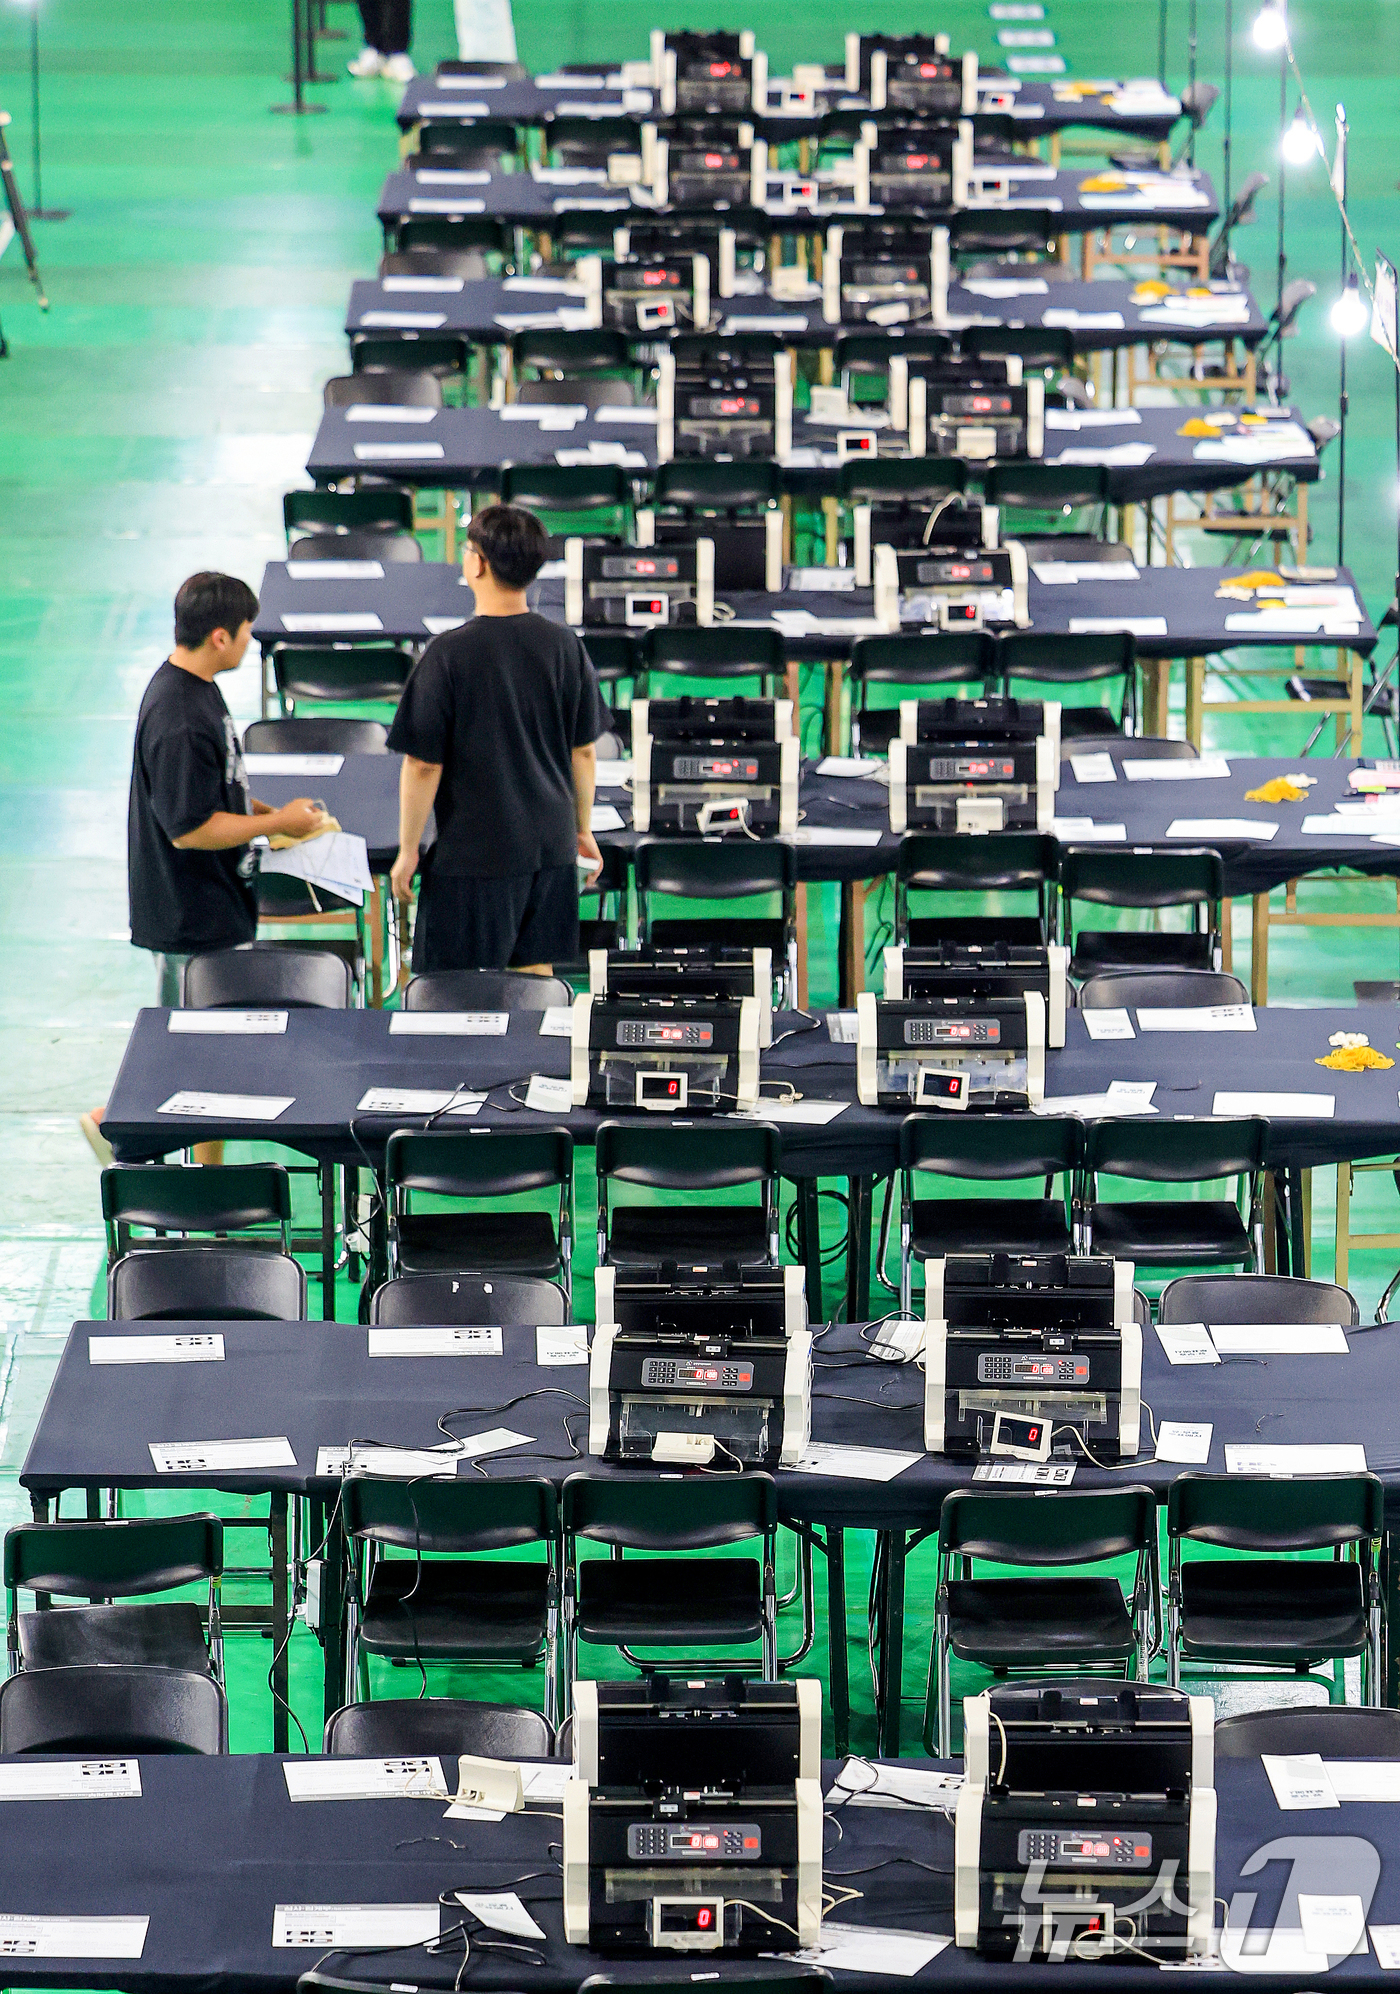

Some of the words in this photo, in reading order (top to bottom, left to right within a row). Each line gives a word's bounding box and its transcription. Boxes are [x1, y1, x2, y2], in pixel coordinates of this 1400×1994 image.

[668, 1081, 678, 1095] 0
[949, 1079, 959, 1093] 0
[1032, 1364, 1039, 1373] 0
[1028, 1427, 1039, 1442] 0
[697, 1908, 711, 1928] 0
